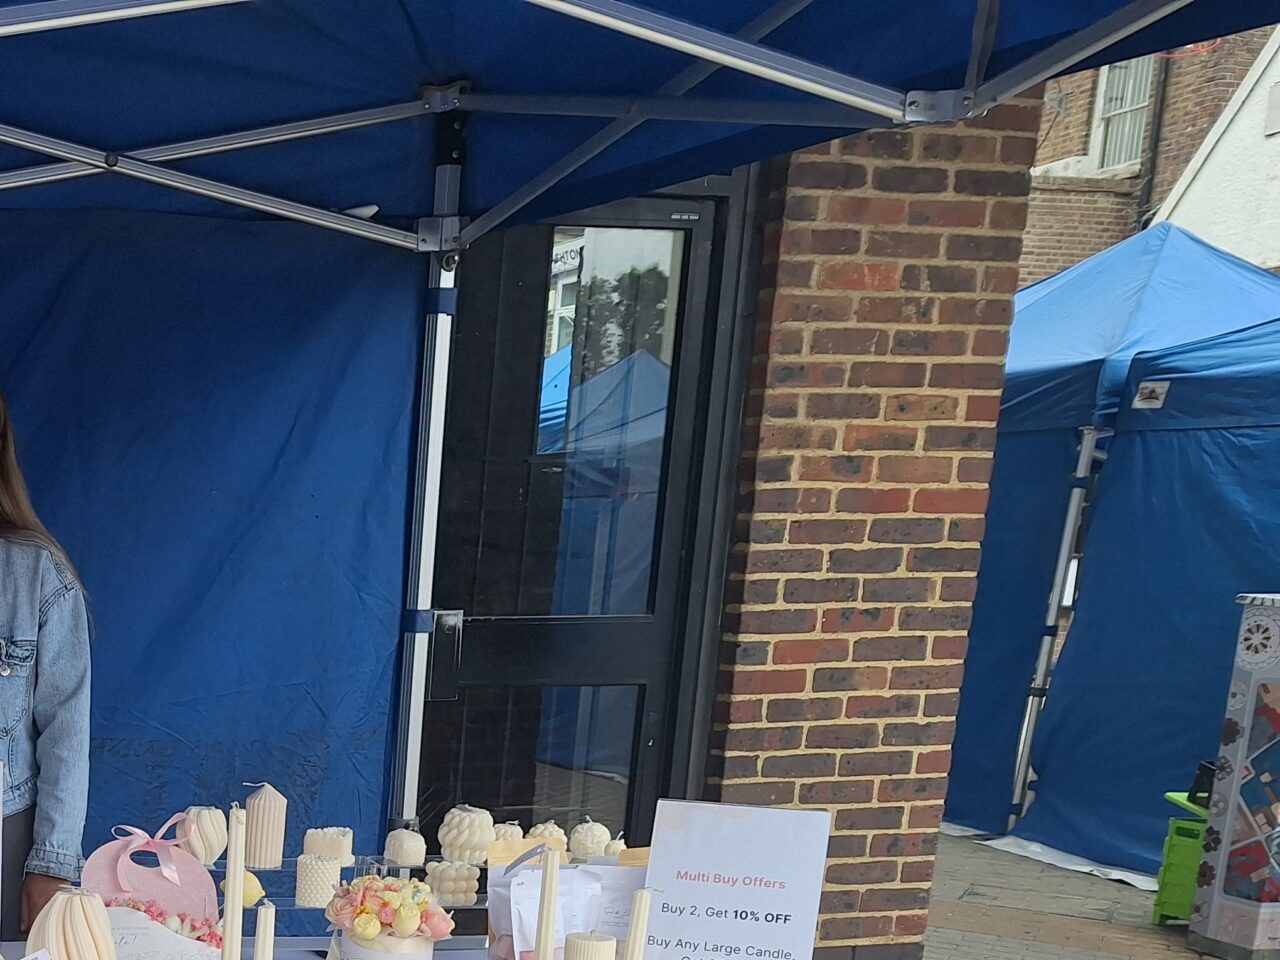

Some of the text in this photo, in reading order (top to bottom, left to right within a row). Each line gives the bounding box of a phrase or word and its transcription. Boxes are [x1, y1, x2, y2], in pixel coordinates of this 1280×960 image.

[676, 870, 786, 889] Multi Buy Offers
[661, 902, 792, 924] Buy 2, Get 10% OFF
[647, 935, 671, 949] Buy
[674, 939, 700, 952] Any
[704, 941, 741, 956] Large
